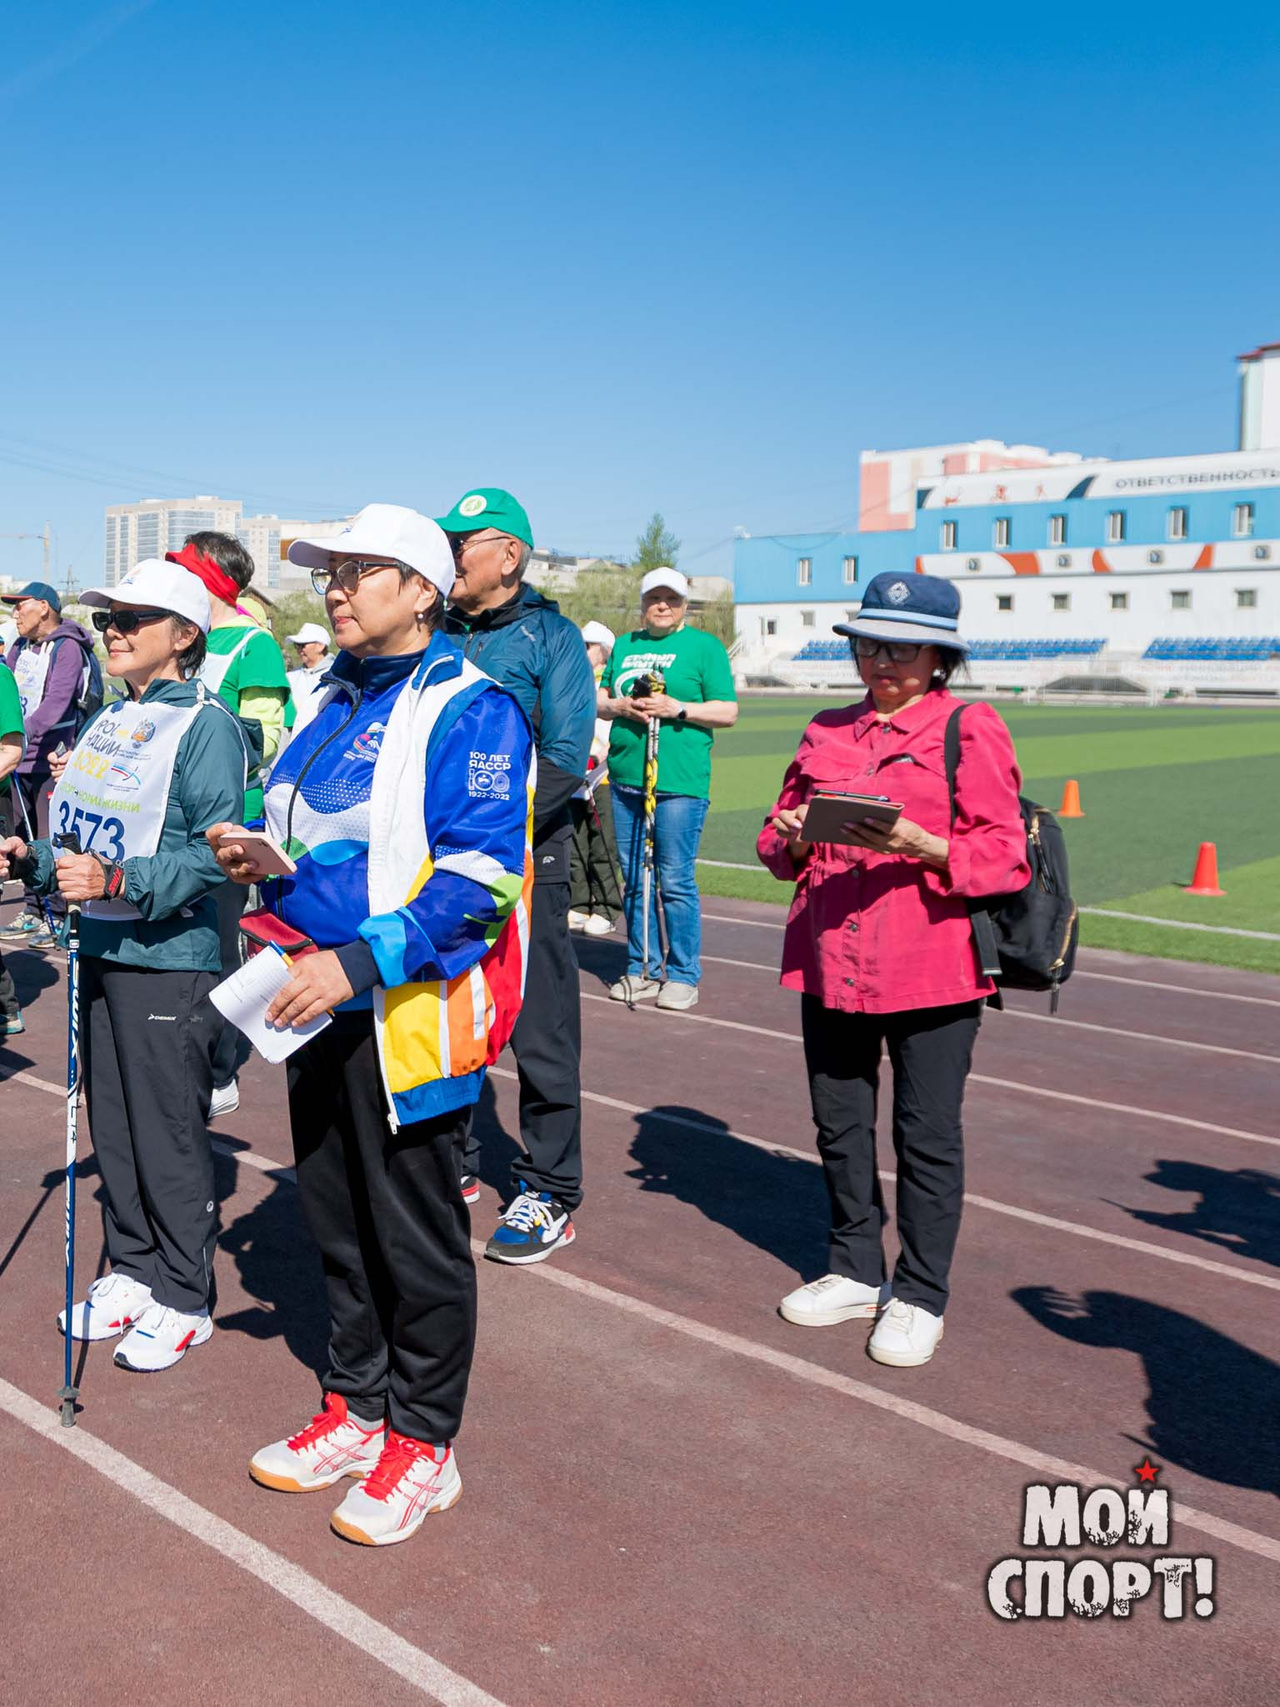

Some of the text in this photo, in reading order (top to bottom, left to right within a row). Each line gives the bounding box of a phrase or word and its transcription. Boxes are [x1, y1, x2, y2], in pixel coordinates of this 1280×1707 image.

[469, 751, 511, 762] 100 ЛЕТ
[469, 760, 512, 771] ЯАССР
[468, 791, 510, 800] 1922-2022
